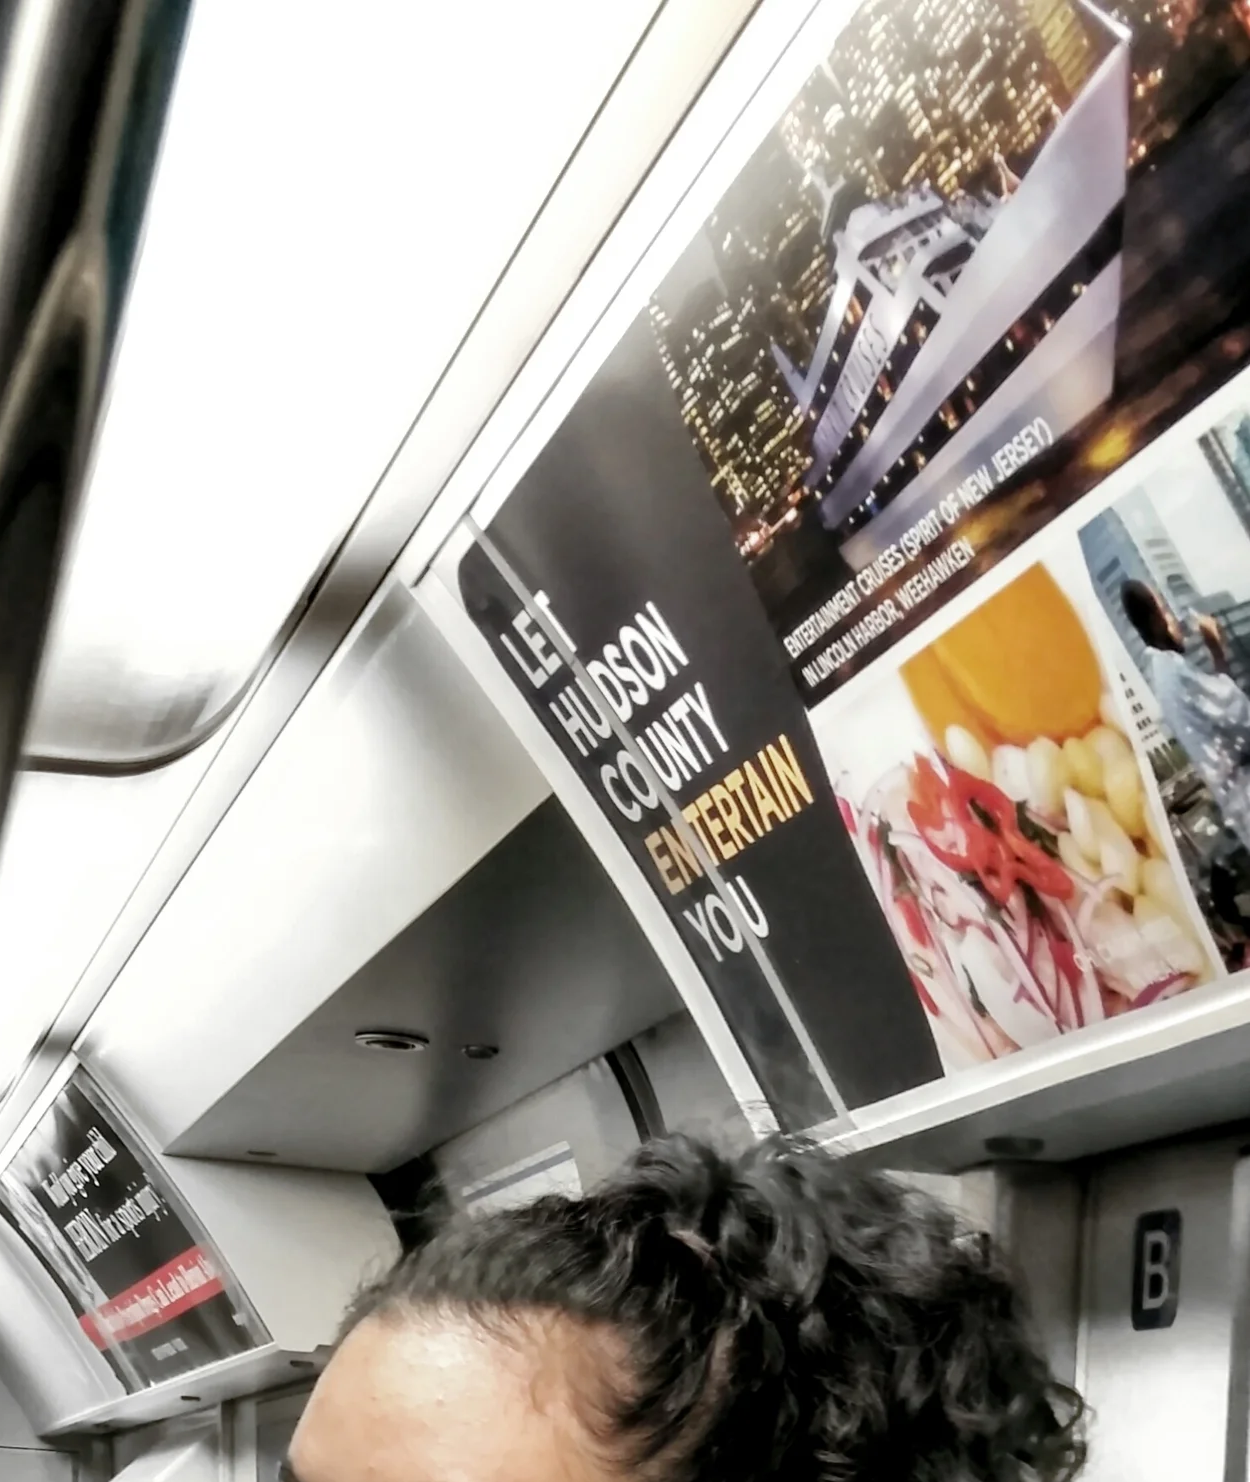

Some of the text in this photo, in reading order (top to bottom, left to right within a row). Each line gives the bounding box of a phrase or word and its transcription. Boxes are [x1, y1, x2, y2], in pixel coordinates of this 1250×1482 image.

[783, 416, 1055, 660] ENTERTAINMENT CRUISES (SPIRIT OF NEW JERSEY)
[500, 590, 577, 689] LET
[801, 536, 977, 688] IN LINCOLN HARBOR, WEEHAWKEN
[549, 601, 690, 757] HUDSON
[600, 682, 730, 823] COUNTY
[644, 733, 814, 895] ENTERTAIN
[682, 875, 770, 962] YOU
[63, 1157, 90, 1198] give
[76, 1146, 106, 1187] your
[64, 1208, 112, 1262] HEROIN
[95, 1213, 122, 1243] for
[110, 1213, 127, 1235] a
[114, 1197, 147, 1239] sports
[1142, 1229, 1171, 1311] B
